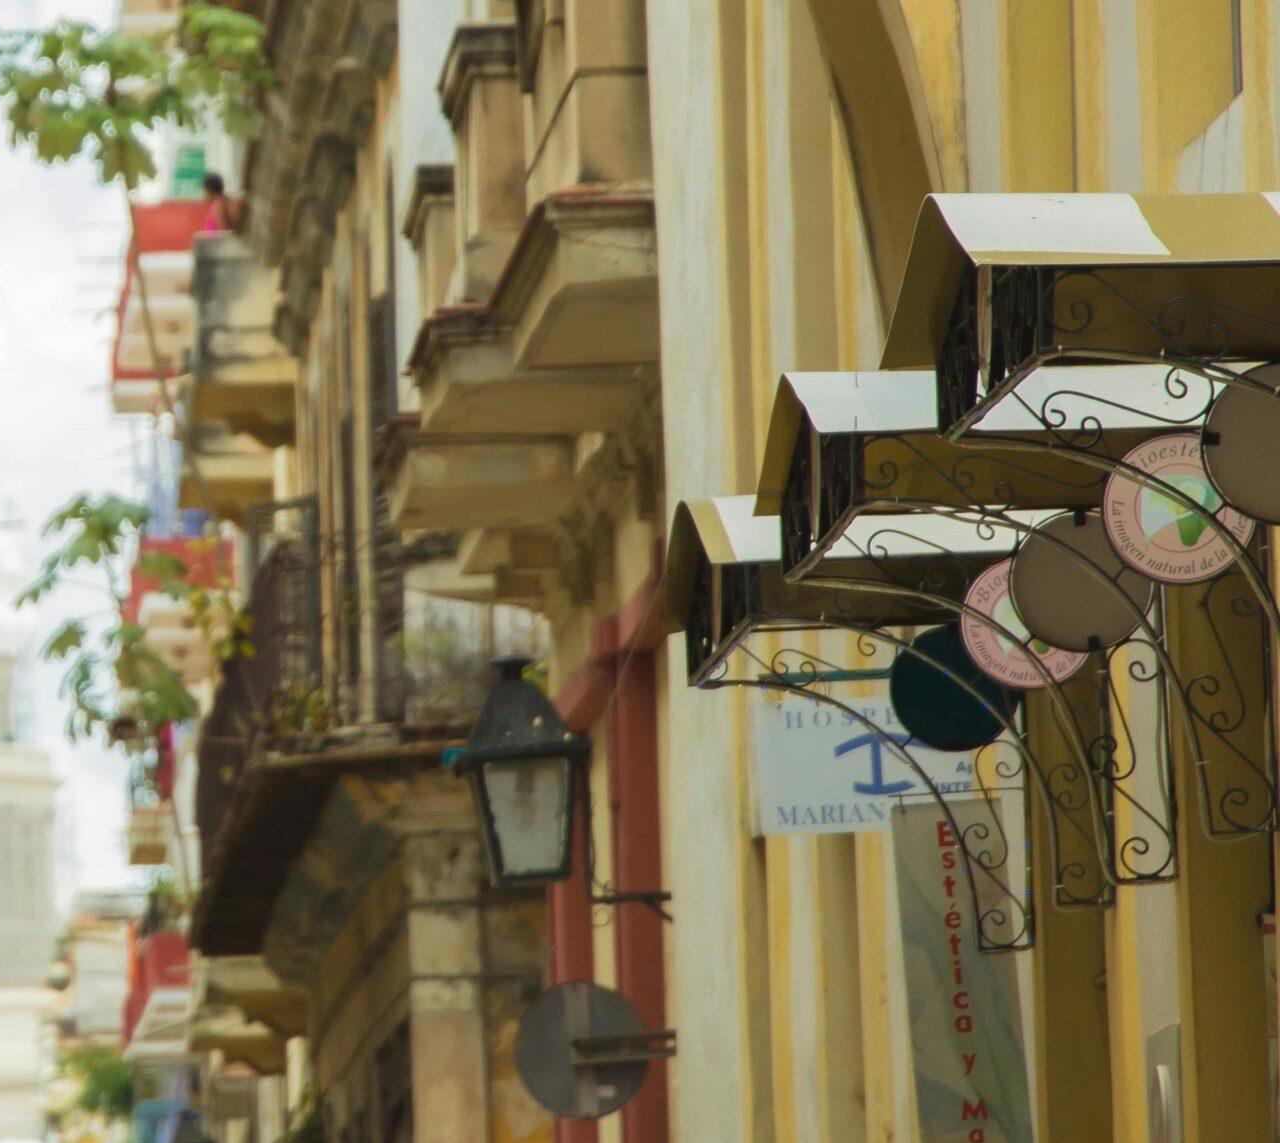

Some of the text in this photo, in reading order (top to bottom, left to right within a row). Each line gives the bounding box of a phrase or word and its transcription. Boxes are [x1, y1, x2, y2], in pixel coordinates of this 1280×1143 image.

[1111, 500, 1125, 516] La
[1113, 519, 1145, 561] imagen
[1200, 556, 1216, 571] de
[1214, 549, 1229, 562] la
[1147, 557, 1196, 575] natural
[970, 624, 981, 638] La
[974, 641, 1007, 674] imagen
[777, 802, 889, 826] MARIAN
[936, 820, 973, 1034] Estética
[961, 1053, 977, 1076] y
